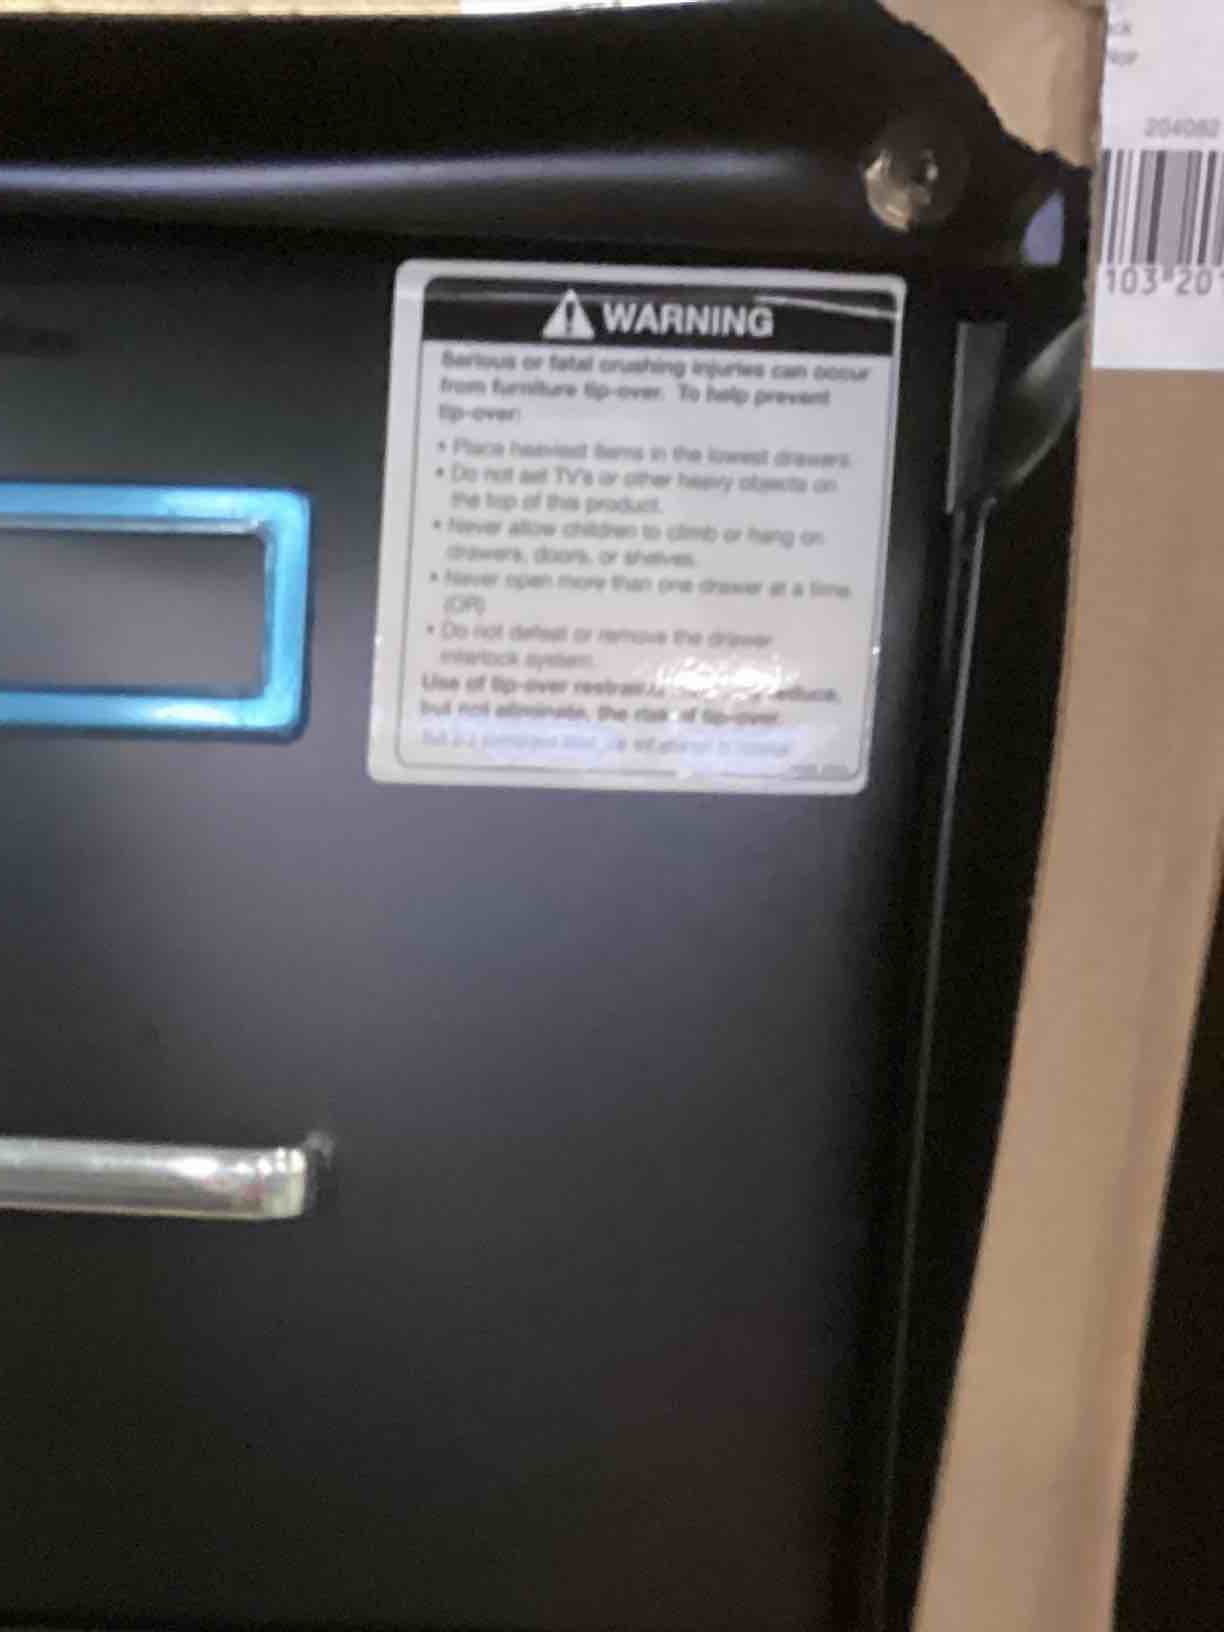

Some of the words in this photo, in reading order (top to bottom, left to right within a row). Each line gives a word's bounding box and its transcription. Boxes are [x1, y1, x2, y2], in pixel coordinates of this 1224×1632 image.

[602, 301, 774, 337] WARNING
[442, 349, 517, 371] Serious
[522, 354, 544, 371] or
[549, 352, 594, 372] fatal
[599, 355, 686, 379] crushing
[691, 358, 765, 380] injuries
[771, 363, 808, 381] can
[813, 364, 870, 383] occur
[440, 376, 487, 394] from
[492, 377, 578, 398] furniture
[677, 383, 701, 403] To
[705, 384, 750, 407] help
[753, 387, 831, 409] prevent
[452, 437, 505, 457] Place
[594, 441, 644, 461] items
[650, 444, 667, 461] in
[673, 445, 702, 464] the
[707, 445, 769, 466] lowest
[450, 463, 476, 483] Do
[482, 466, 514, 485] not
[597, 471, 619, 487] or
[622, 470, 671, 489] other
[676, 471, 734, 493] heavy
[812, 477, 838, 495] on
[450, 490, 480, 509] the
[484, 492, 517, 513] top
[521, 491, 543, 511] of
[546, 492, 580, 512] this
[447, 515, 503, 536] Never
[507, 517, 558, 538] allow
[562, 520, 638, 541] children
[642, 522, 662, 541] to
[722, 527, 743, 544] or
[799, 529, 824, 546] on
[598, 551, 618, 567] or
[444, 568, 500, 588] Never
[505, 572, 553, 592] open
[557, 573, 607, 591] more
[611, 573, 653, 593] than
[658, 577, 693, 595] one
[769, 580, 788, 598] at
[792, 582, 804, 598] a
[440, 620, 468, 641] Do
[472, 622, 504, 642] not
[572, 628, 593, 644] or
[597, 627, 668, 646] remove
[673, 628, 703, 647] the
[707, 627, 773, 649] drawer
[422, 673, 460, 693] Use
[464, 674, 486, 694] of
[421, 699, 452, 717] but
[458, 701, 490, 719] not
[596, 704, 627, 722] the
